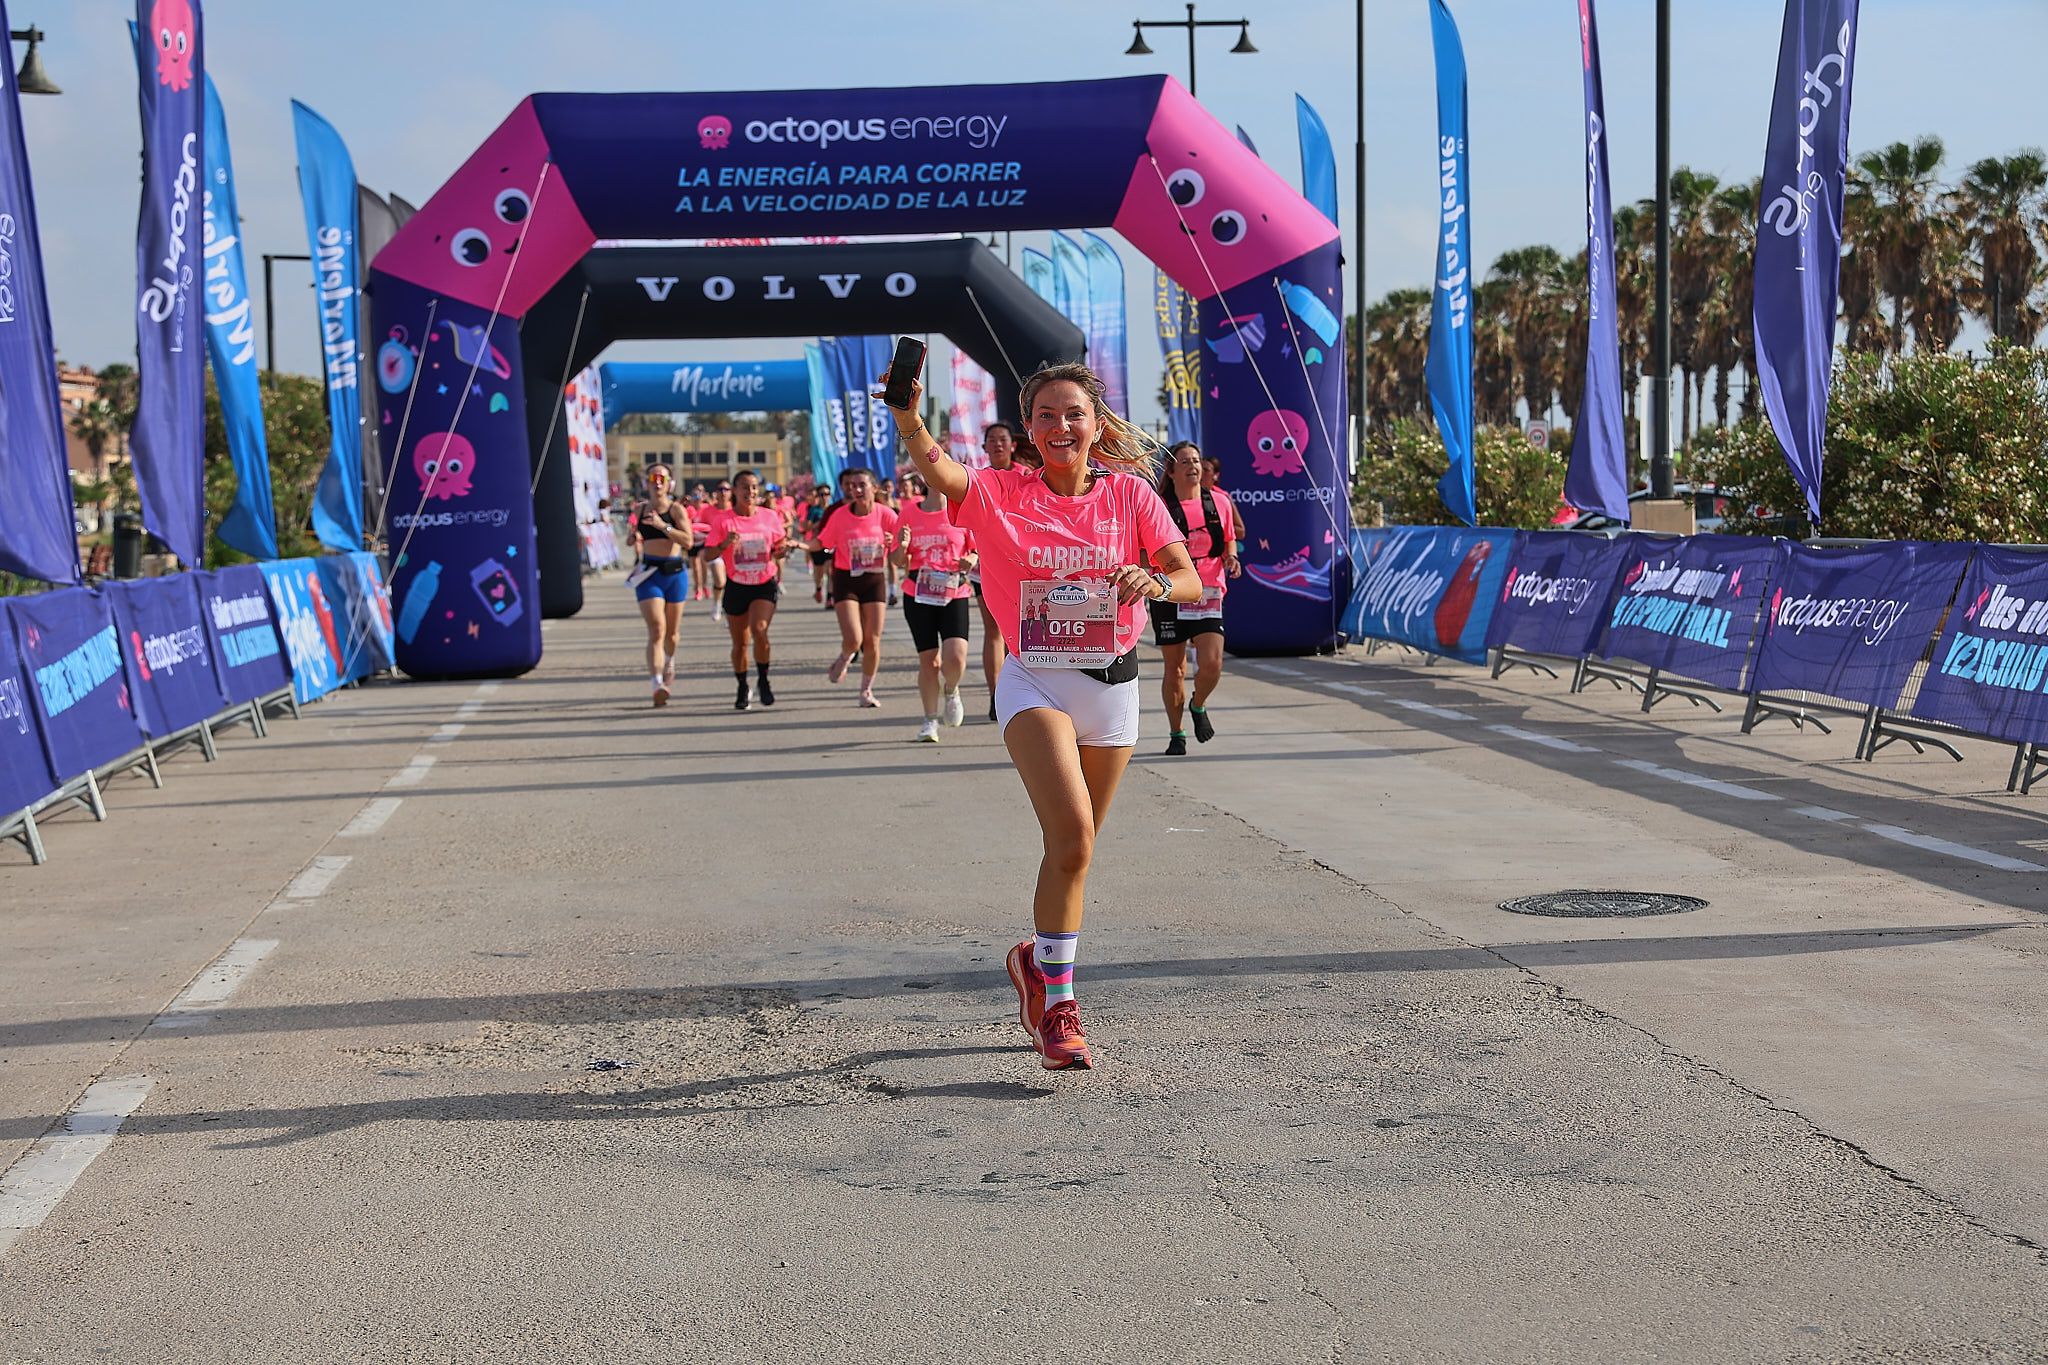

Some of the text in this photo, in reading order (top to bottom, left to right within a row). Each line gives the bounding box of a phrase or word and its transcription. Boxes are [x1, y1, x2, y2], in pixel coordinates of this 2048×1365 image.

[678, 161, 1021, 188] LA ENERGÍA PARA CORRER
[675, 189, 1028, 213] A LA VELOCIDAD DE LA LUZ
[636, 270, 918, 302] VOLVO
[671, 364, 765, 408] Marlene
[1229, 488, 1285, 507] ctopus
[1024, 523, 1064, 533] OYSHO
[1028, 545, 1120, 570] CARRERA
[1352, 530, 1444, 637] Marlene
[1050, 592, 1087, 601] ASTURIANA
[1980, 583, 2026, 630] Has
[1049, 620, 1086, 636] 016
[1028, 655, 1058, 663] OYSHO
